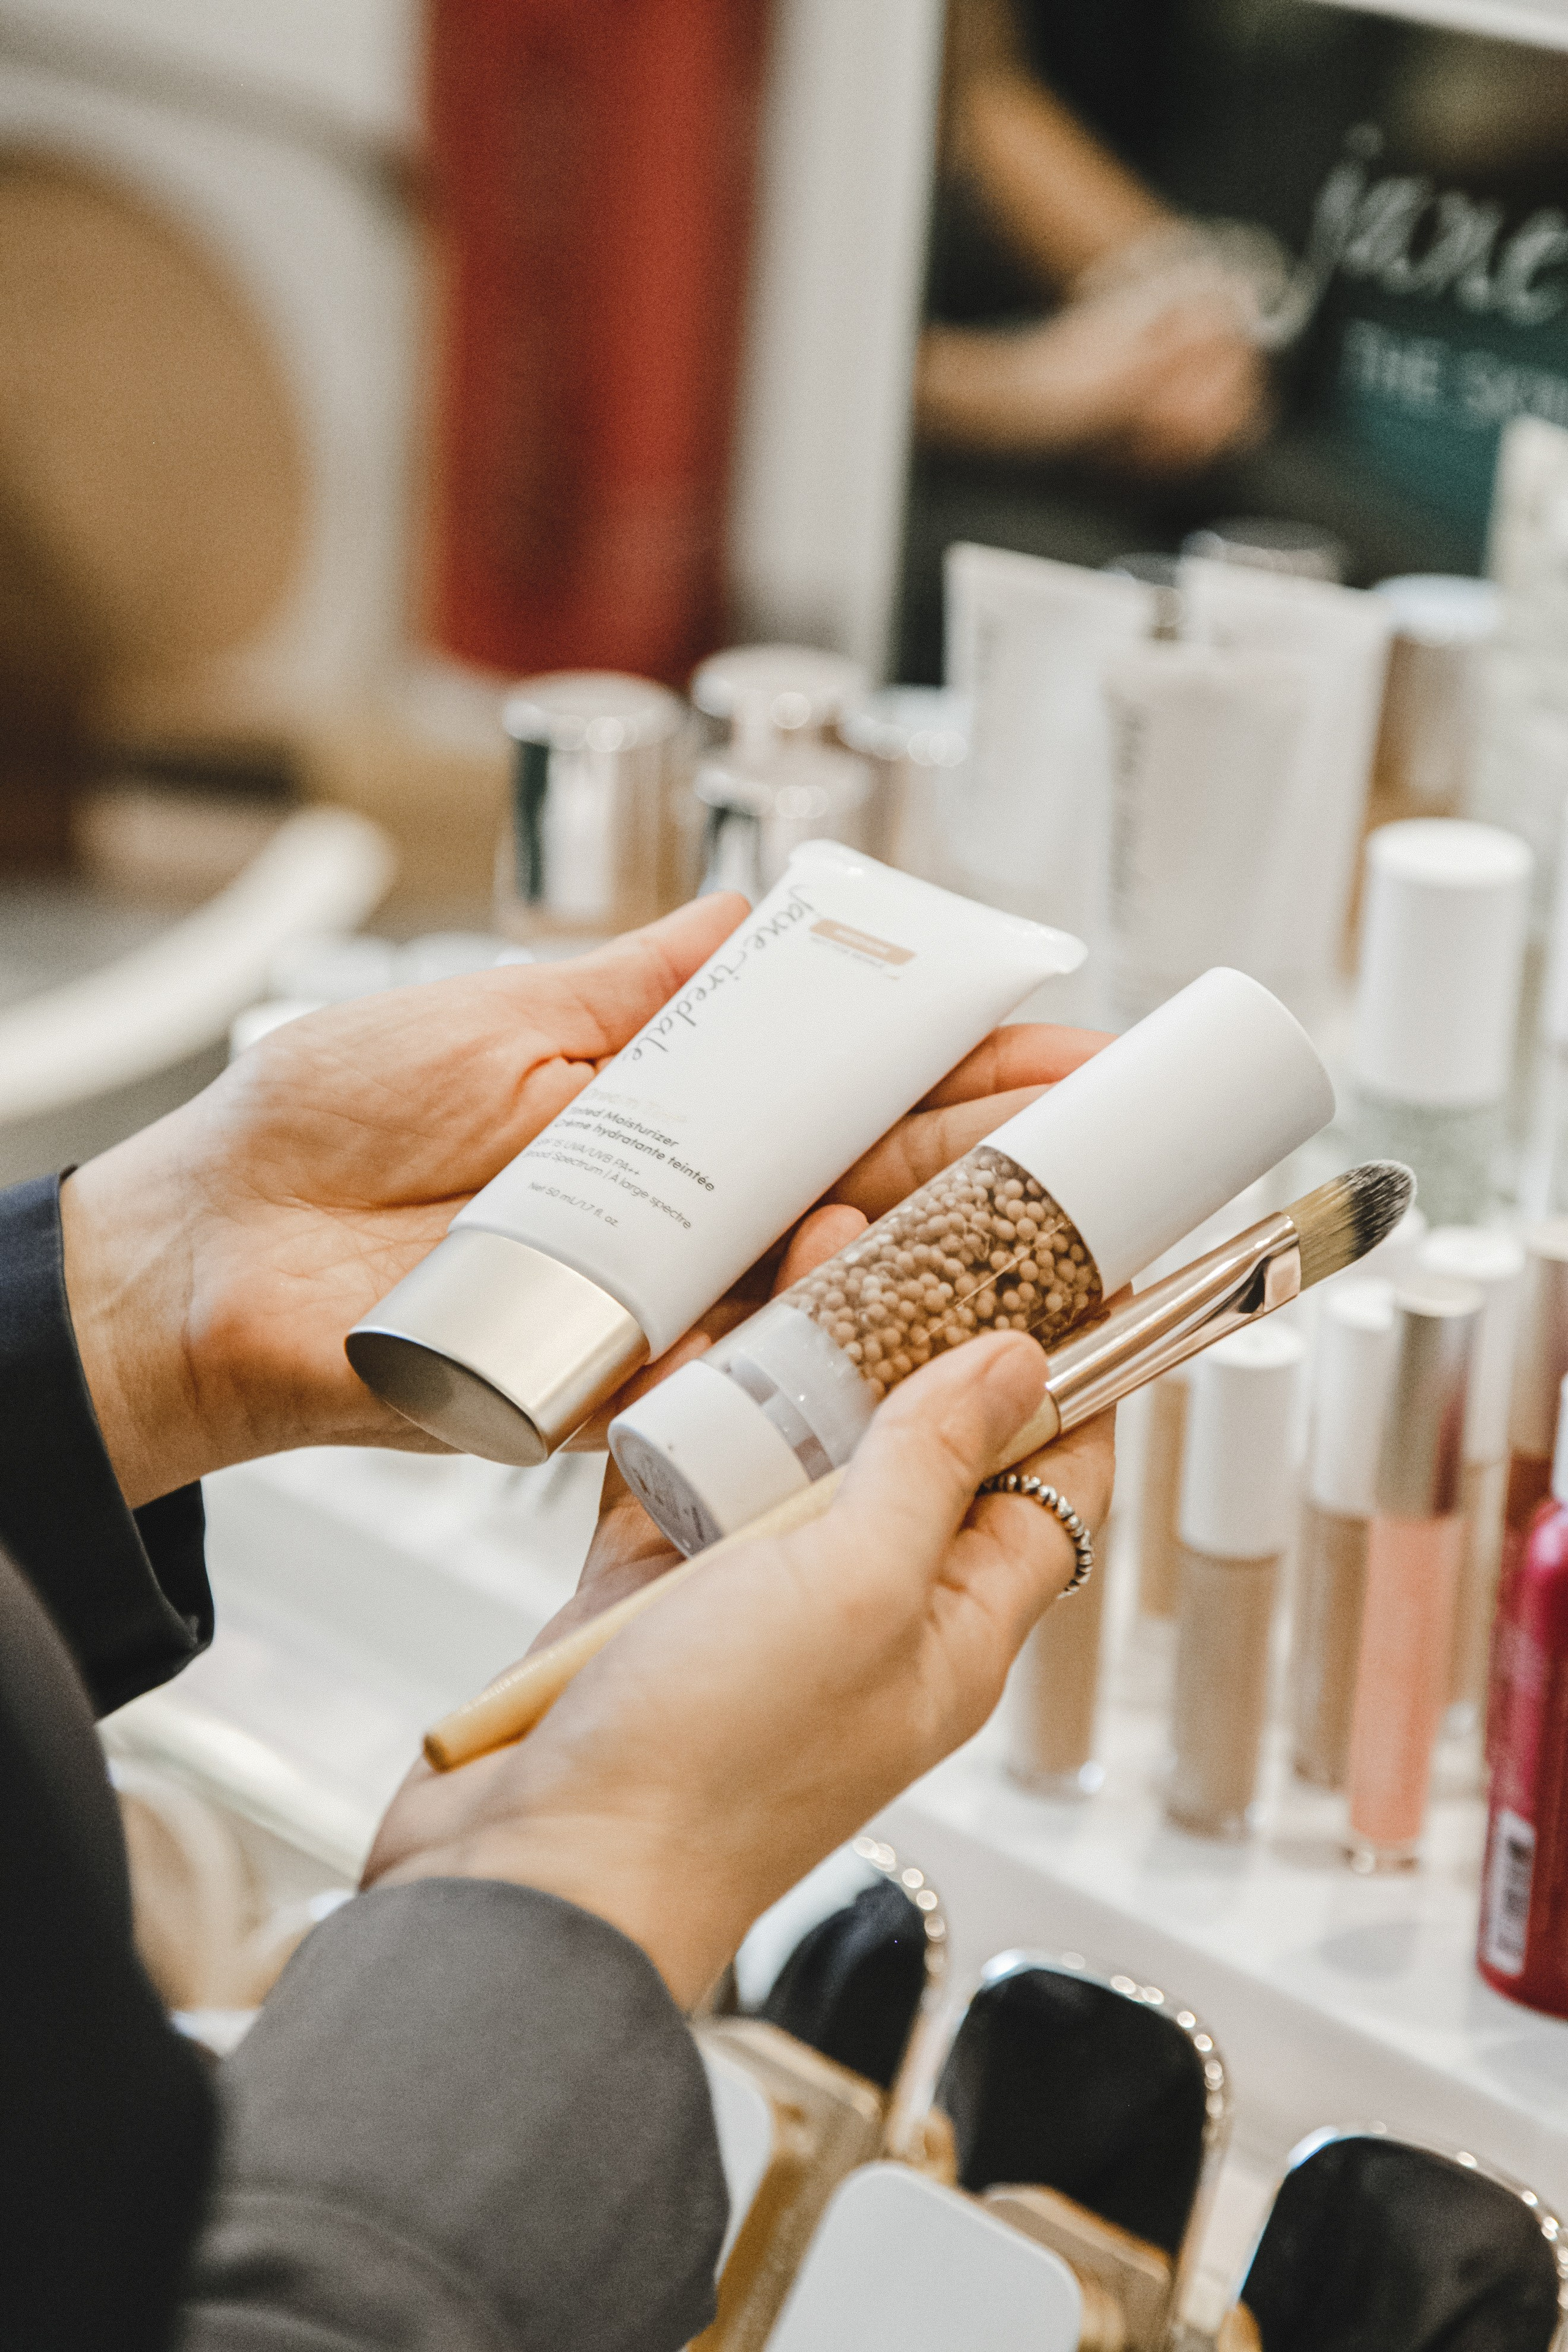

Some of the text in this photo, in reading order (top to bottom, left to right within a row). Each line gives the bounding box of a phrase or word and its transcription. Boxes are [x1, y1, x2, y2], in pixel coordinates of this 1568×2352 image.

[742, 883, 823, 949] jane
[621, 950, 747, 1061] iredale
[593, 1123, 666, 1160] hydratante
[667, 1156, 715, 1191] teintée
[602, 1111, 679, 1148] Moisturizer
[545, 1186, 561, 1197] 50
[551, 1151, 605, 1176] Spectrum
[619, 1177, 650, 1199] large
[649, 1195, 692, 1230] spectre
